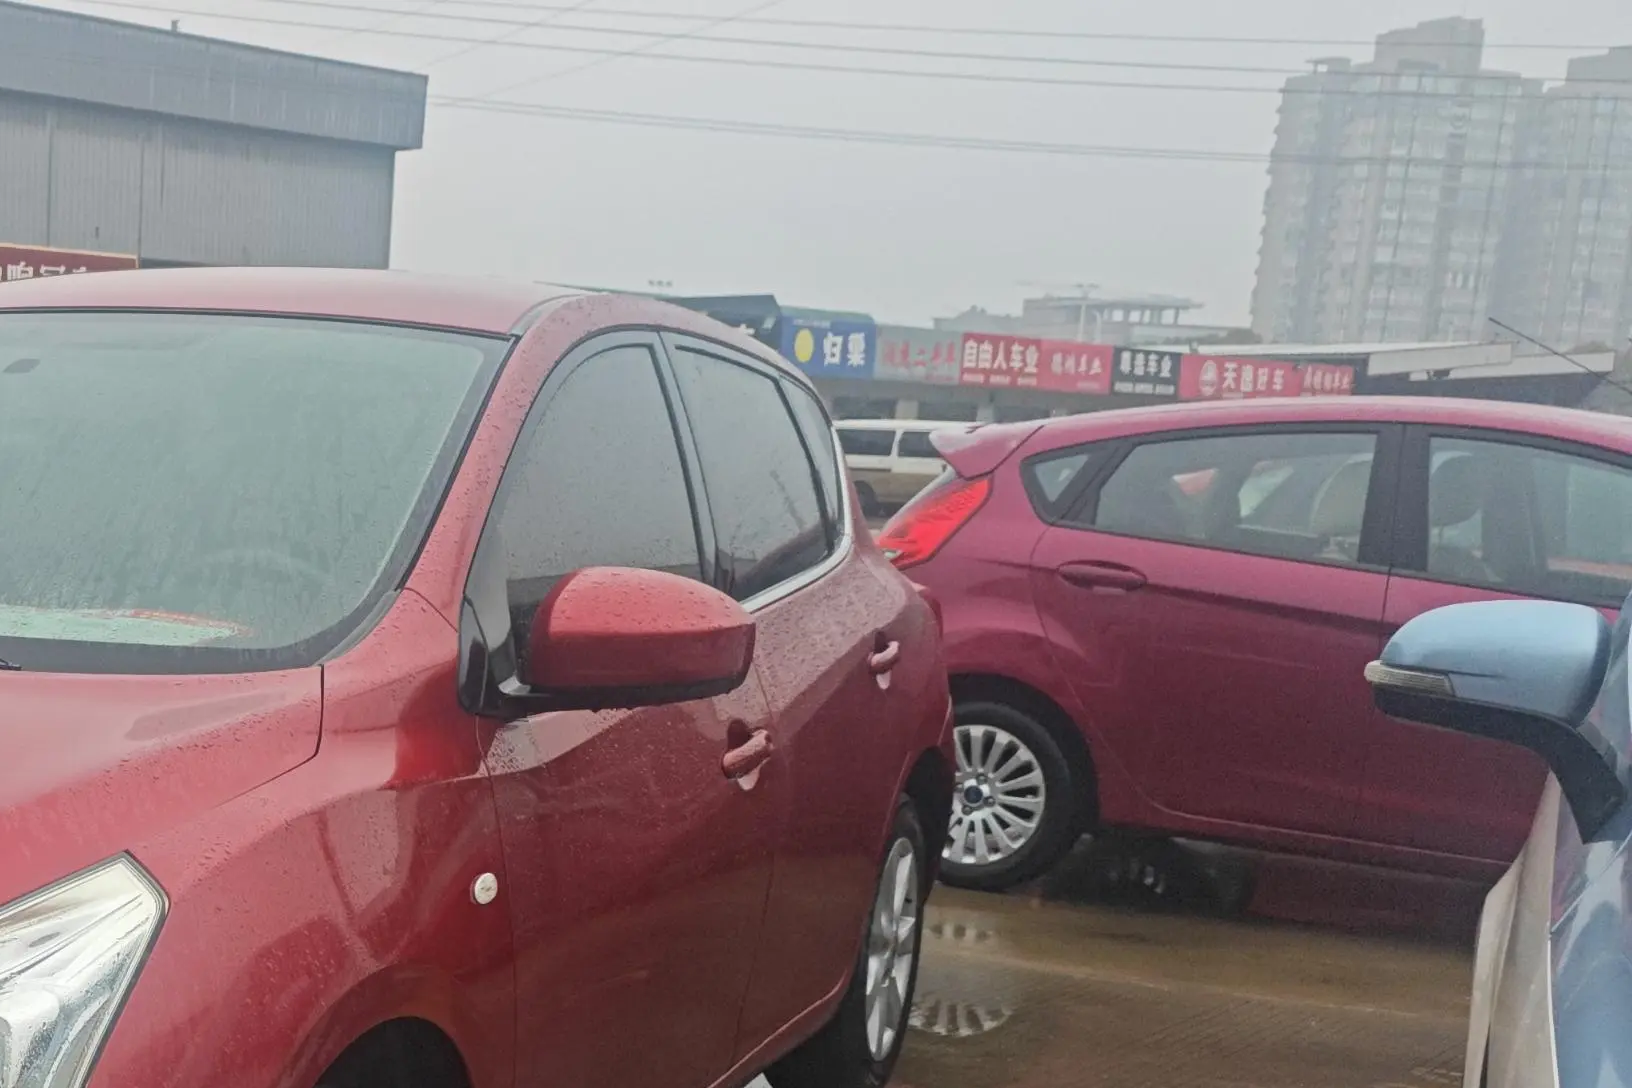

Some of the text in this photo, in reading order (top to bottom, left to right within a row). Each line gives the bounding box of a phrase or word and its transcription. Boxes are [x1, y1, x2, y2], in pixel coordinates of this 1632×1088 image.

[963, 338, 1040, 373] 自由人车业
